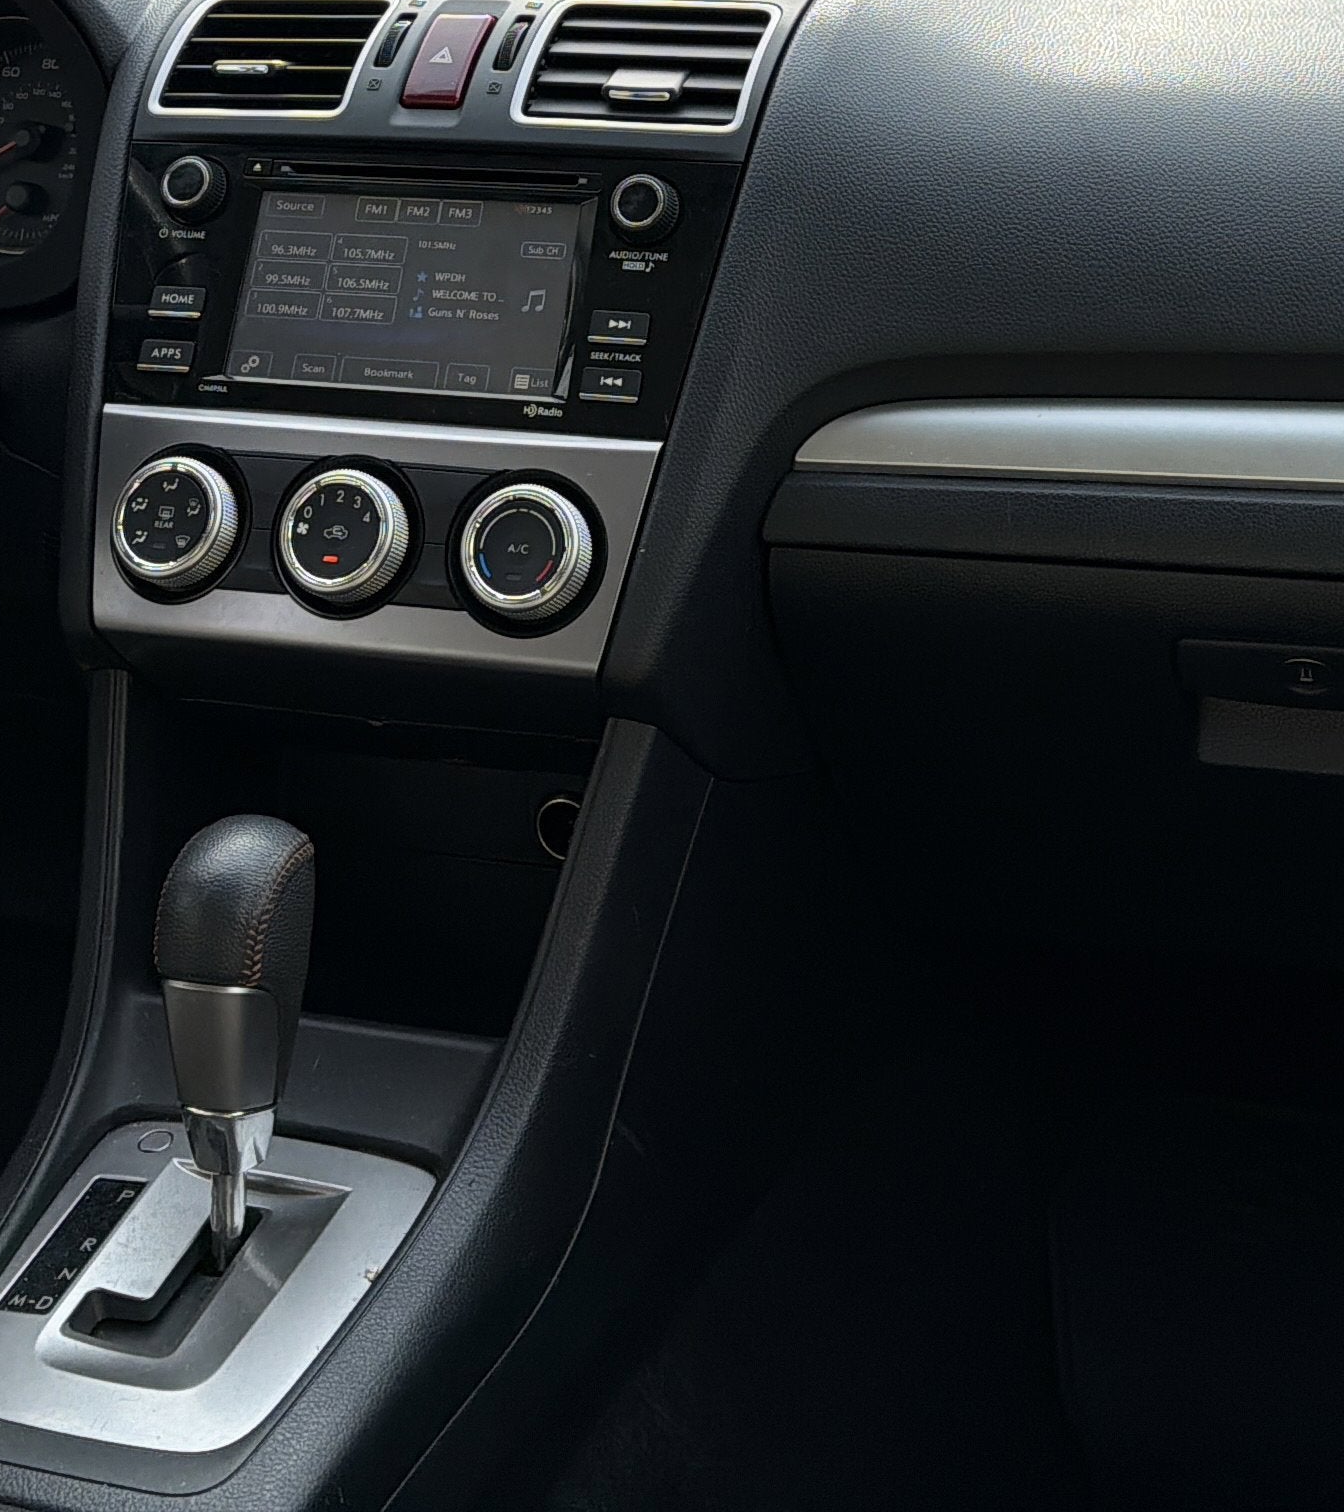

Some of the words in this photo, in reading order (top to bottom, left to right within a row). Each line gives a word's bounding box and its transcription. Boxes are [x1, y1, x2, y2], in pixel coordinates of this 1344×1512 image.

[1, 67, 21, 78] 60
[276, 200, 315, 212] Source
[364, 204, 388, 215] FM1
[406, 206, 430, 217] FM2
[448, 208, 472, 219] FM3
[171, 230, 206, 239] VOLUME
[271, 244, 318, 257] 96.3MHz
[343, 248, 395, 261] 105.7MHz
[528, 245, 544, 255] Sub
[546, 246, 559, 256] CH
[608, 250, 669, 262] AUDIO/TUNE
[265, 273, 311, 286] 99.5MHz
[435, 272, 466, 282] WPDH
[337, 277, 390, 290] 106.5MHz
[161, 293, 195, 305] HOME
[432, 290, 479, 302] WELCOME
[256, 303, 308, 316] 100.9MHz
[331, 307, 384, 320] 107.7MHz
[428, 307, 453, 318] Guns
[469, 310, 500, 320] Roses
[151, 347, 182, 359] APPS
[590, 351, 642, 362] SEEK/TRACK
[302, 363, 325, 374] Scan
[364, 367, 414, 380] Bookmark
[457, 372, 477, 385] Tag
[531, 377, 549, 388] List
[537, 406, 563, 417] Radio
[320, 494, 325, 506] 1
[336, 490, 345, 502] 2
[353, 496, 362, 508] 3
[303, 506, 313, 519] 0
[362, 511, 371, 523] 4
[154, 520, 174, 529] REAR
[507, 543, 530, 555] A/C
[117, 1190, 135, 1202] P
[80, 1237, 97, 1252] R
[57, 1267, 77, 1280] N
[8, 1294, 53, 1309] M-D
